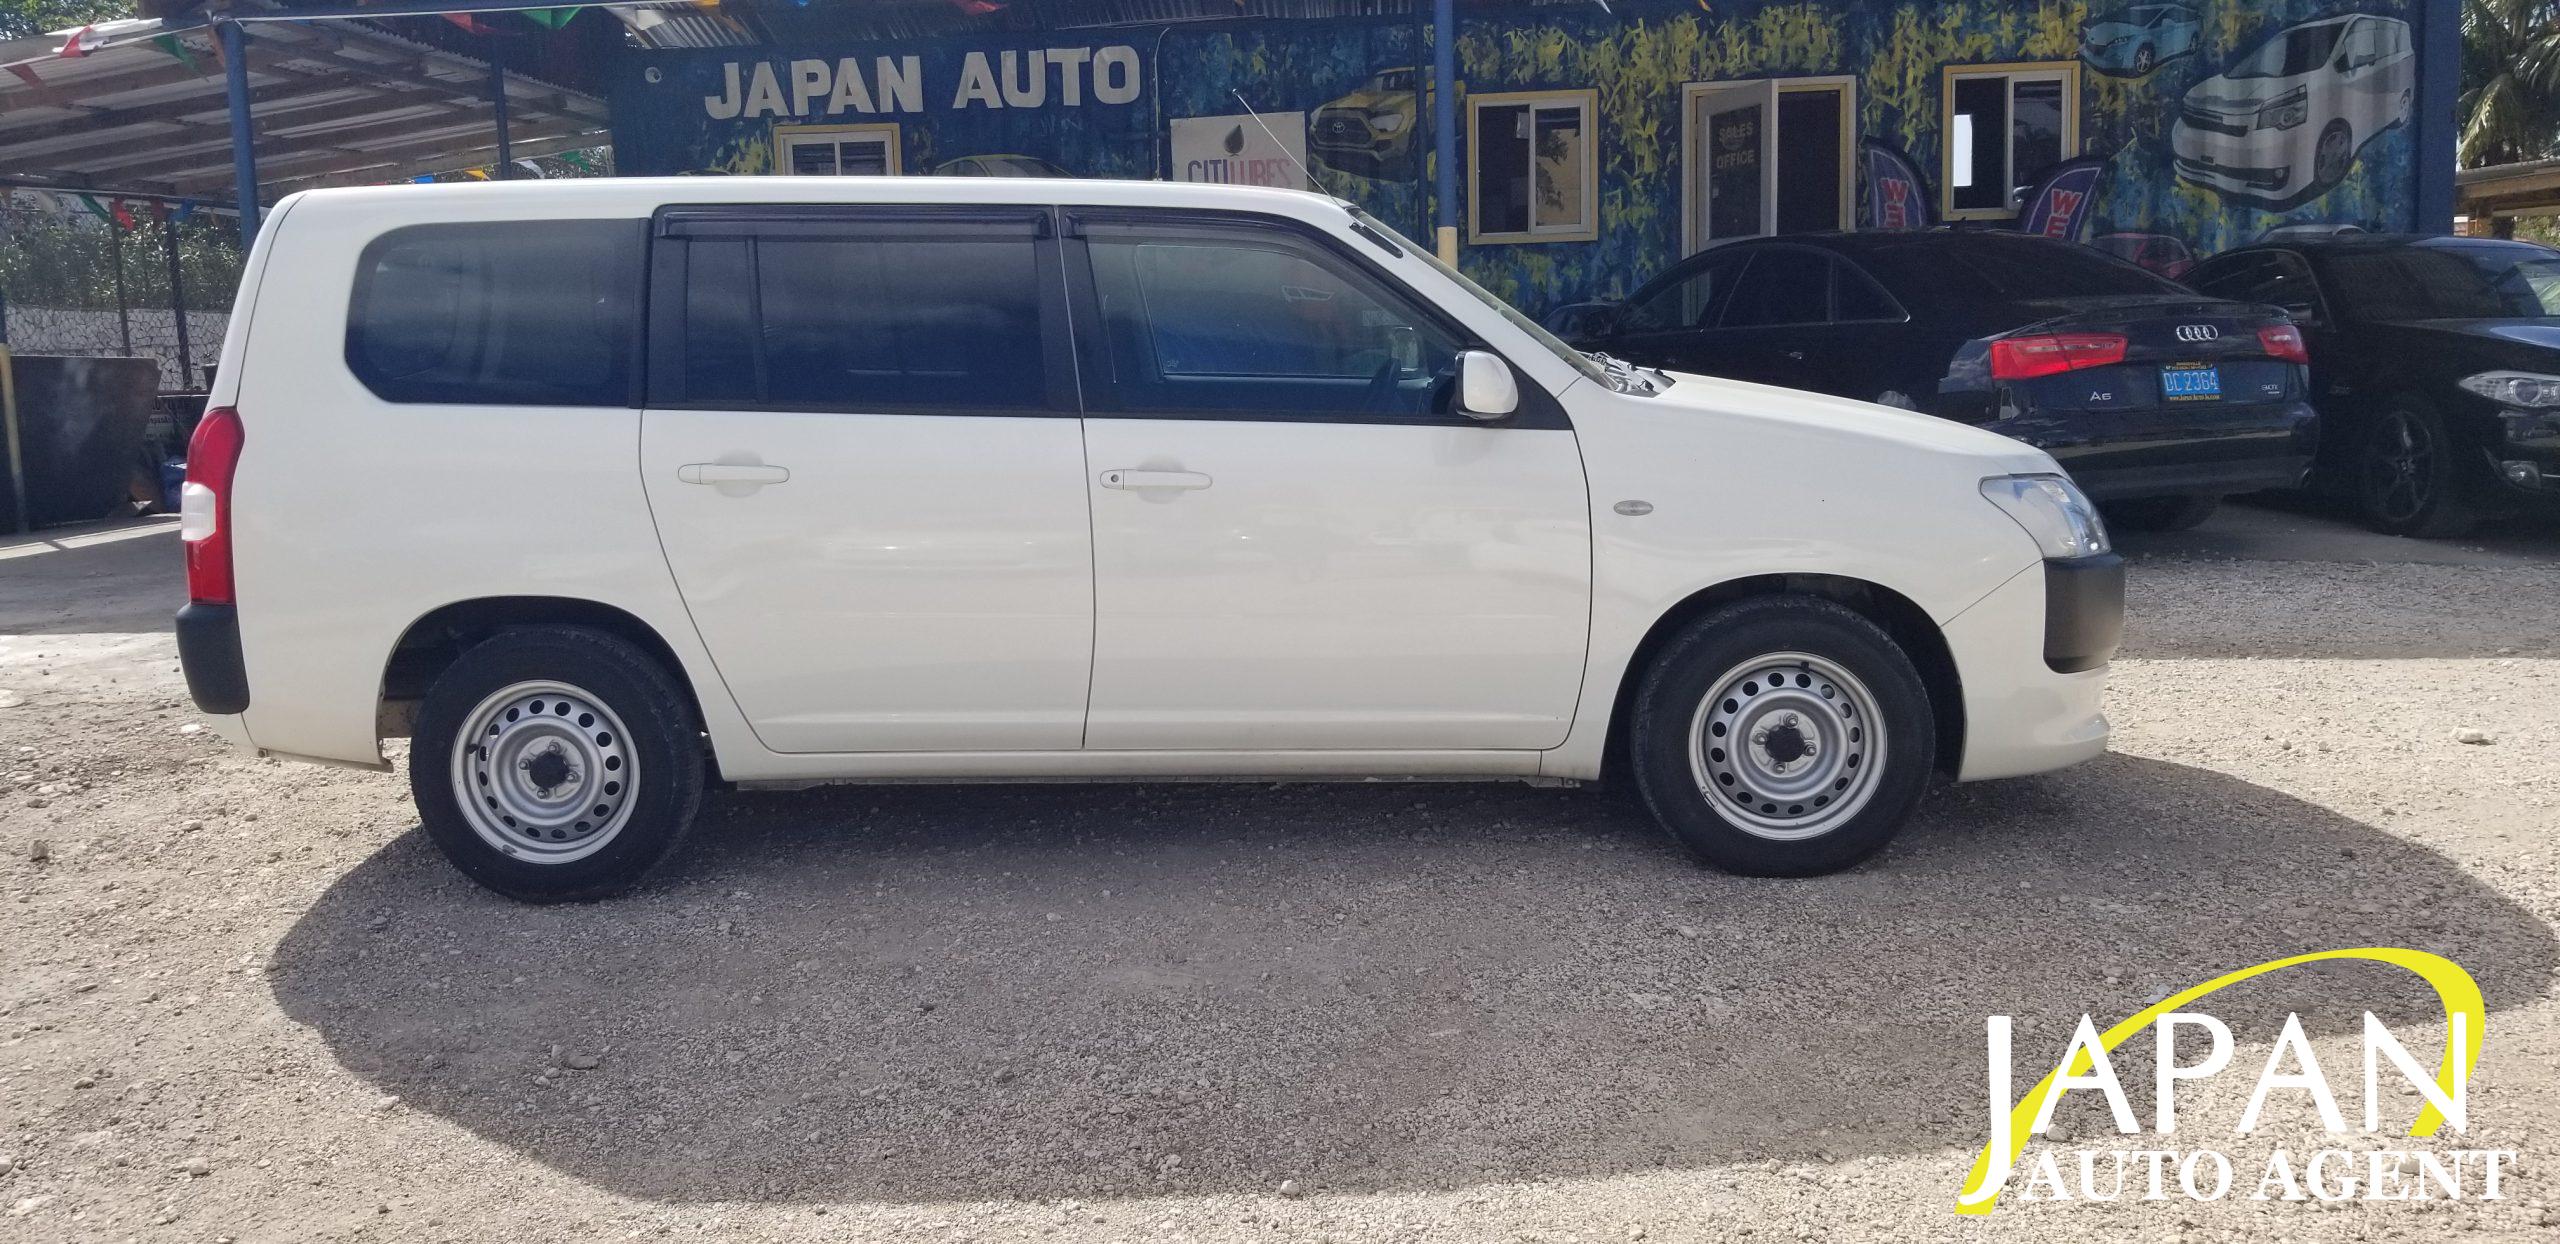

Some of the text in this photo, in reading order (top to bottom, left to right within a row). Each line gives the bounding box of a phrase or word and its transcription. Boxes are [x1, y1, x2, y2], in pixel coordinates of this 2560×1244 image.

[705, 45, 1141, 120] JAPAN AUTO
[1719, 121, 1754, 141] SALES
[1716, 150, 1755, 168] OFFICE
[2090, 391, 2112, 401] A6
